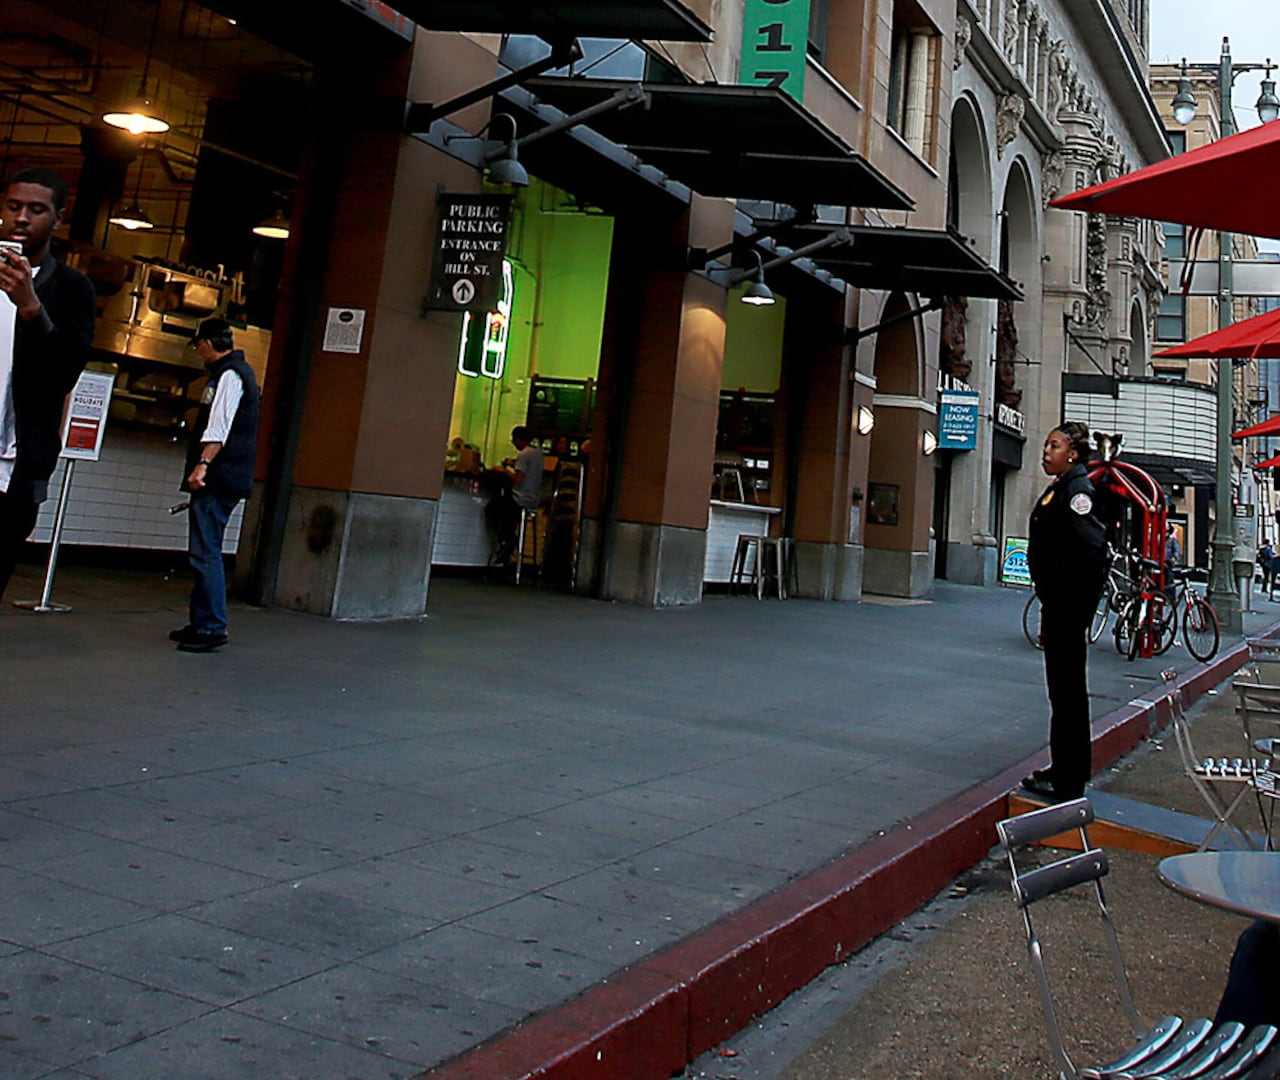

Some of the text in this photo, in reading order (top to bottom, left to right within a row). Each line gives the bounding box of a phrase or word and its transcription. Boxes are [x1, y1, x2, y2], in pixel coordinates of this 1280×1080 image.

[449, 204, 500, 218] PUBLIC
[441, 219, 504, 234] PARKING
[440, 239, 501, 251] ENTRANCE
[460, 252, 476, 262] ON
[444, 263, 471, 275] HILL
[949, 405, 970, 413] NOW
[944, 414, 974, 423] LEASING
